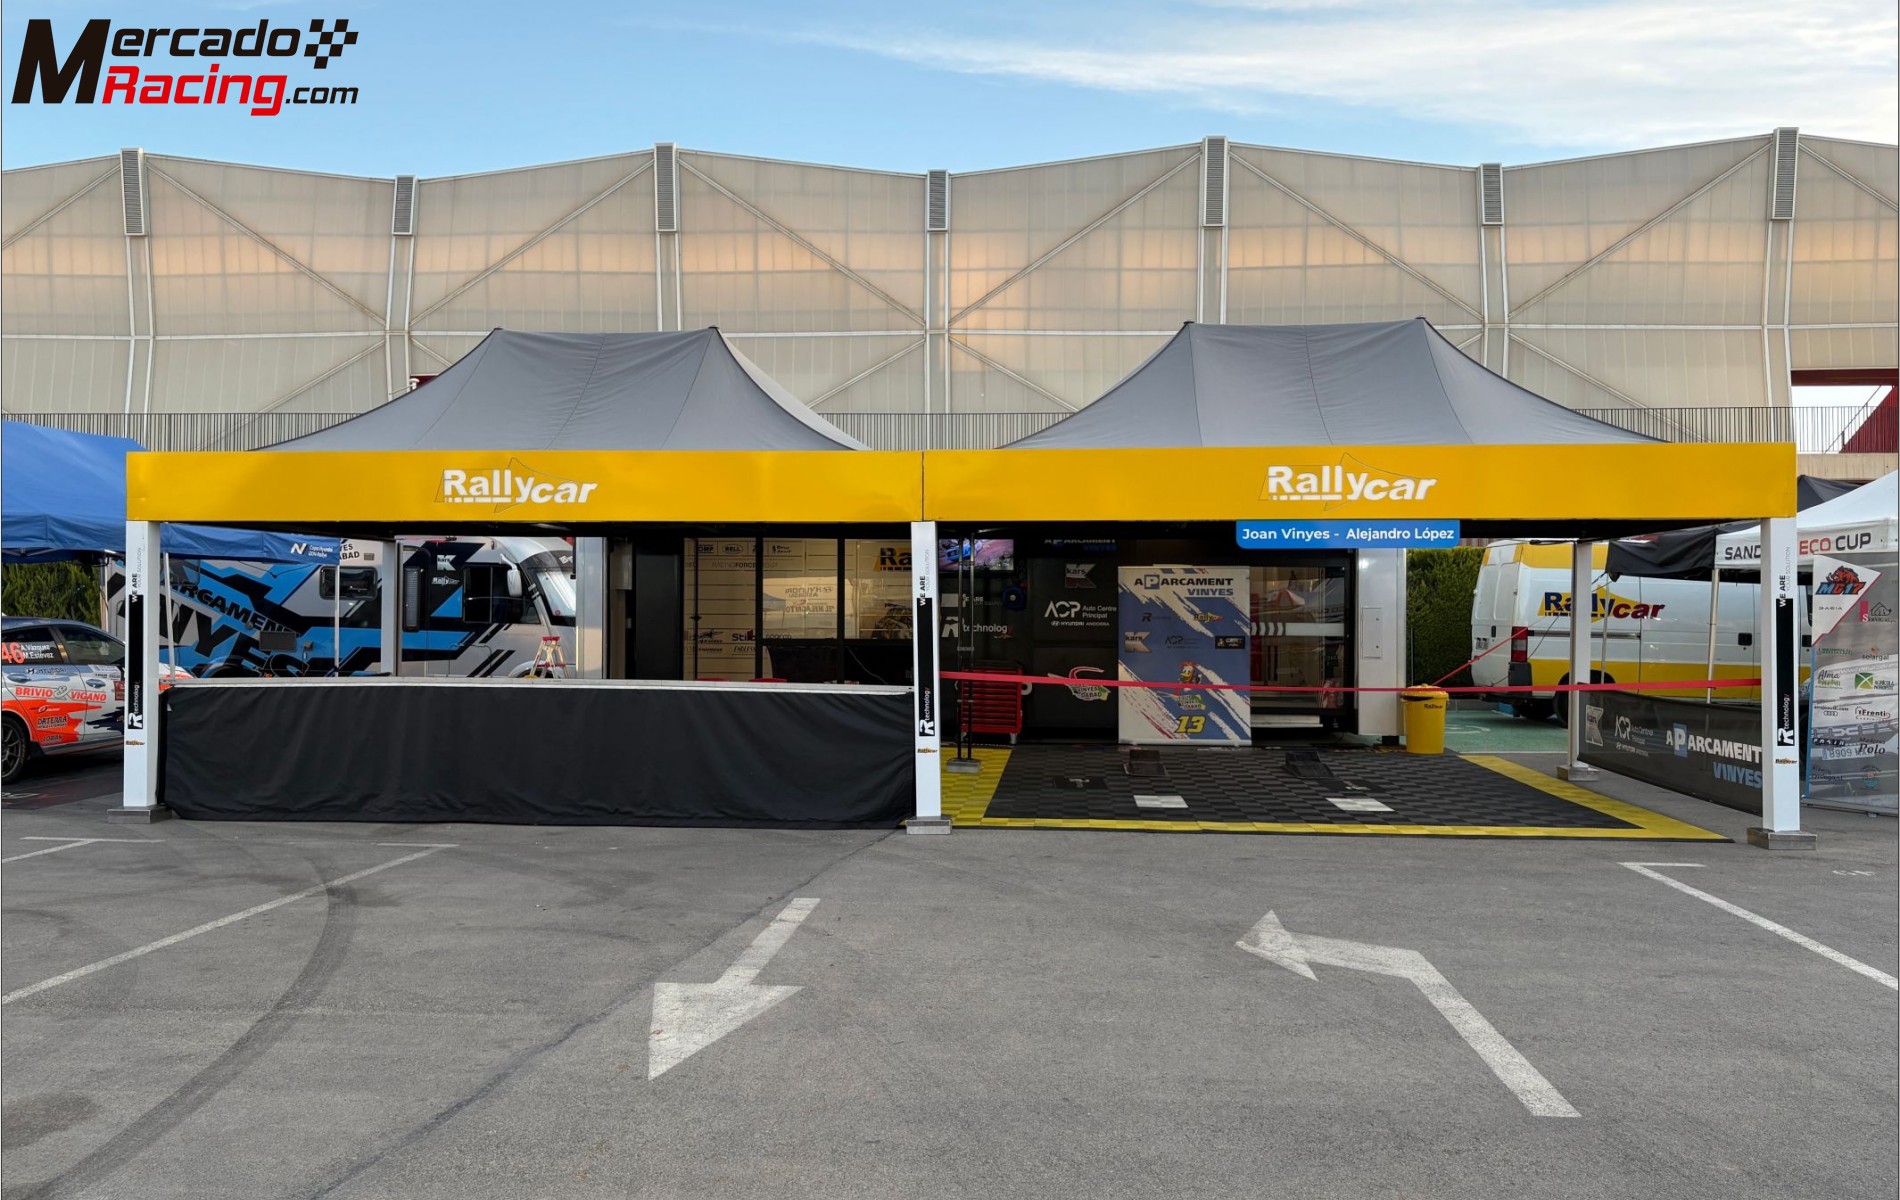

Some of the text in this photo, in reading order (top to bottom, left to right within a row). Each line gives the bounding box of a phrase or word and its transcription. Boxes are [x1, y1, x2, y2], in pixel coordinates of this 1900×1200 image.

[444, 469, 598, 504] Rallycar
[1268, 465, 1438, 500] Rallycar
[1242, 529, 1277, 540] Joan
[1281, 528, 1330, 542] Vinyes
[1346, 528, 1411, 542] Alejandro
[1415, 527, 1454, 542] López
[340, 543, 354, 552] ES
[1799, 538, 1831, 555] ECO
[1836, 533, 1871, 551] CUP
[340, 551, 360, 560] BAD
[1134, 574, 1234, 589] APARCAMENT
[132, 590, 138, 604] WE
[920, 593, 926, 606] WE
[1780, 593, 1786, 607] WE
[1, 642, 25, 664] 46
[15, 686, 53, 698] BRIVIO
[70, 691, 107, 701] VIGANO
[1176, 716, 1206, 734] 13
[1666, 725, 1762, 764] APARCAMENT
[1860, 743, 1885, 755] Polo
[1713, 761, 1762, 789] VINYES
